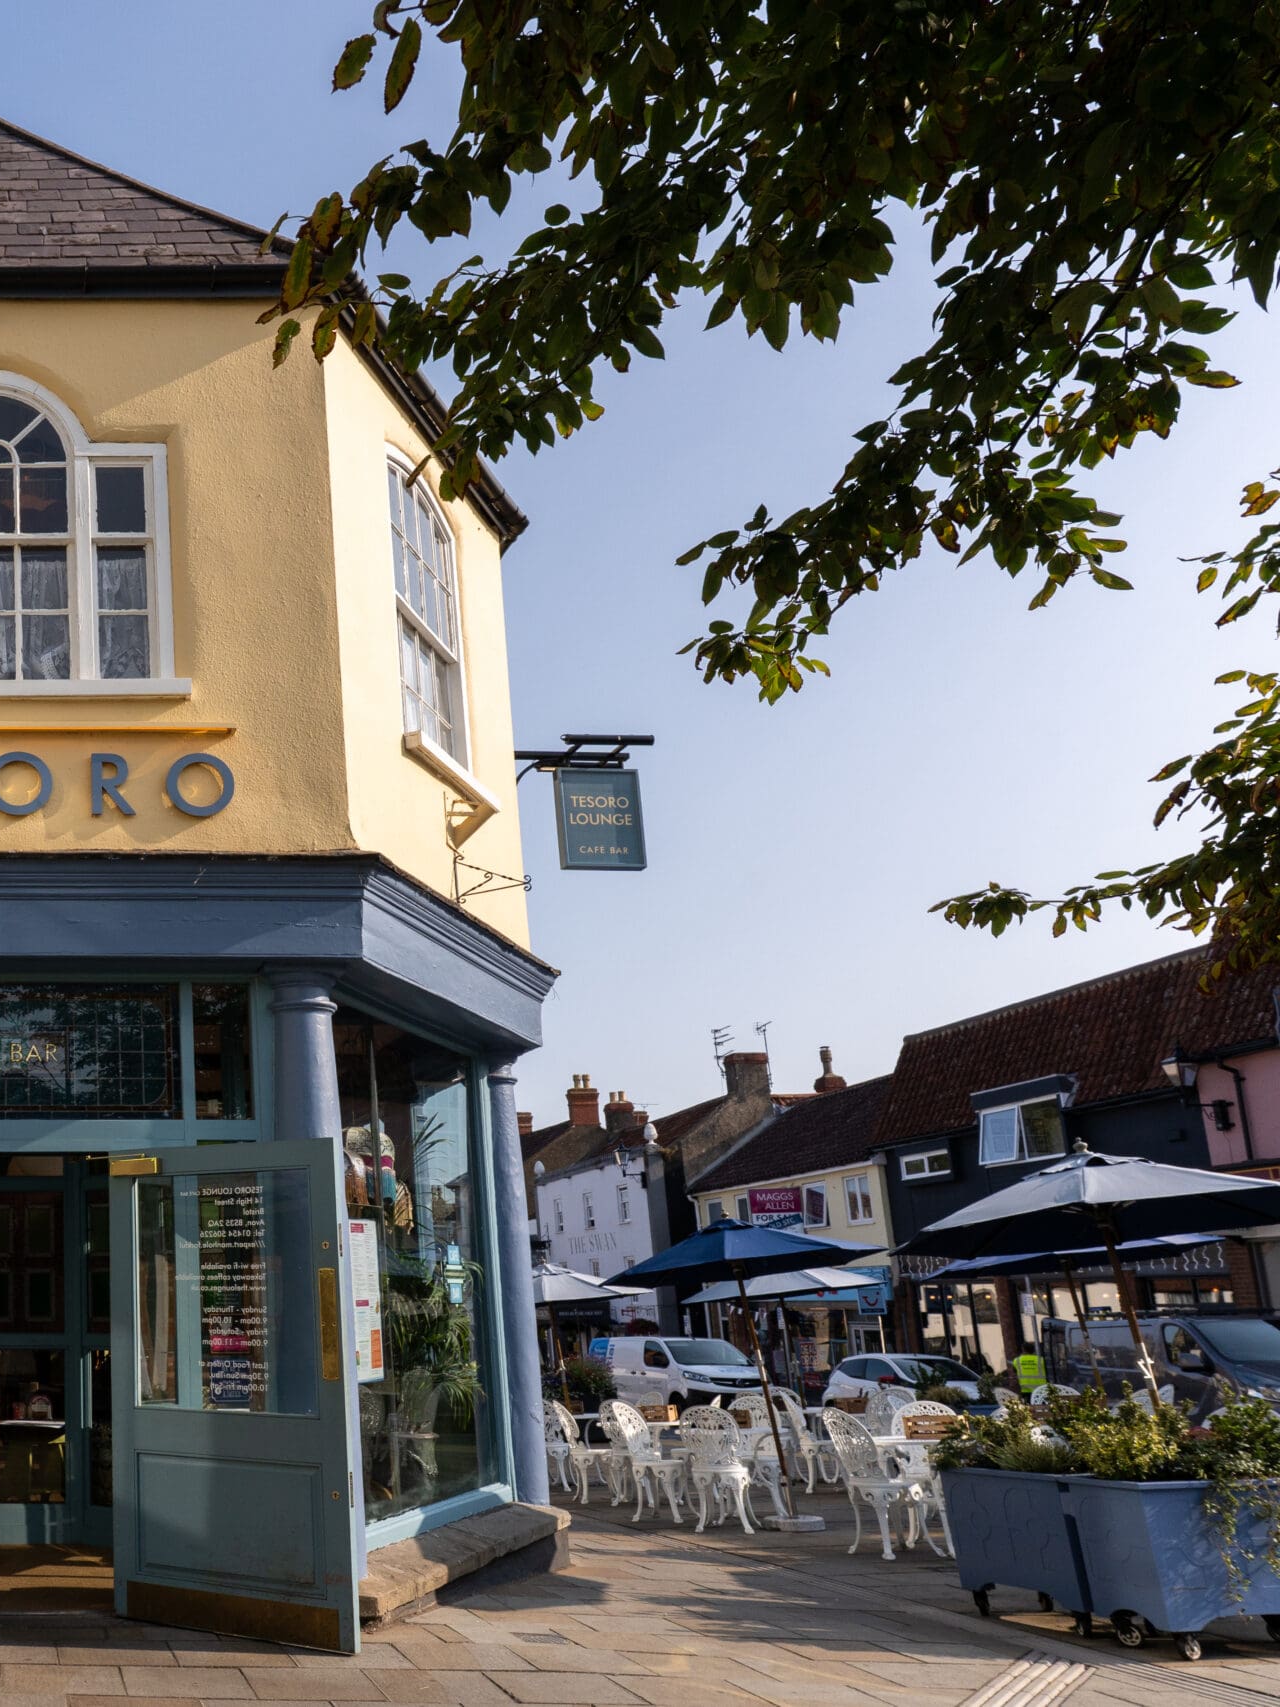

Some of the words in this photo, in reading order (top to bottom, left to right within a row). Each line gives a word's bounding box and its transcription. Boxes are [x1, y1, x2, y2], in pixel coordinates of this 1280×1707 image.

[570, 795, 629, 808] TESORO
[570, 813, 633, 825] LOUNGE
[609, 846, 629, 855] BAR
[10, 1043, 58, 1063] BAR
[756, 1192, 794, 1201] MAGGS
[765, 1201, 795, 1210] ALLEN
[756, 1214, 775, 1222] FOR
[568, 1235, 587, 1255] THE
[589, 1231, 617, 1252] SWAN
